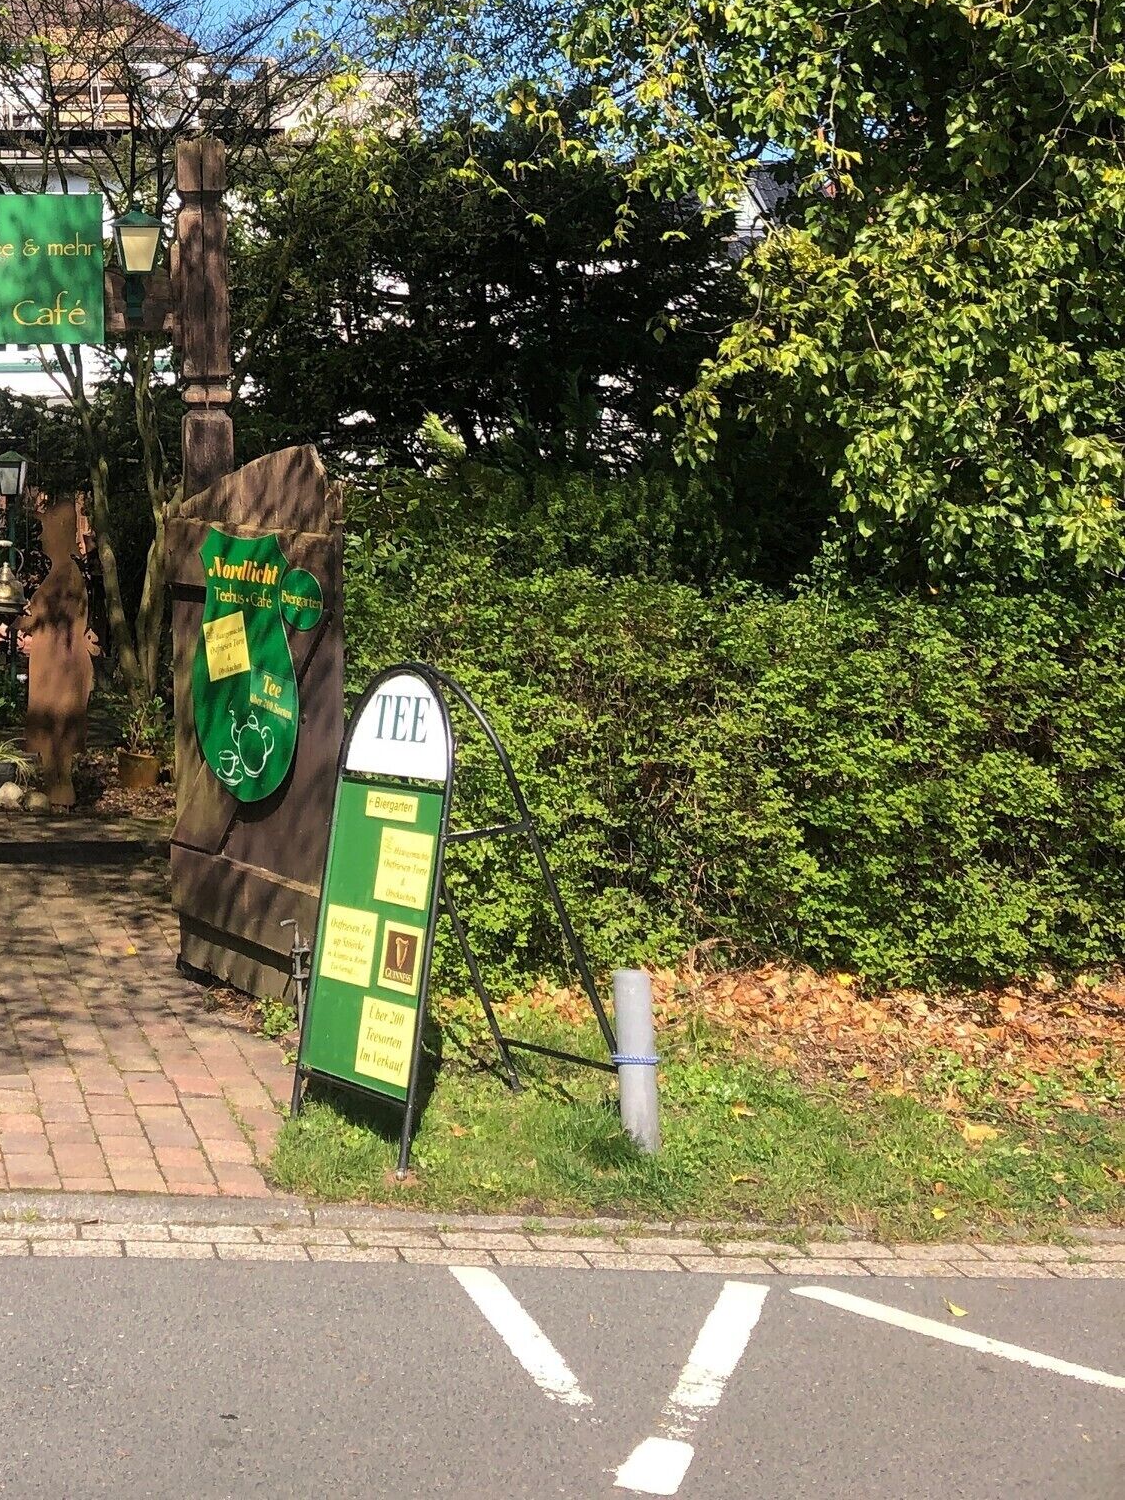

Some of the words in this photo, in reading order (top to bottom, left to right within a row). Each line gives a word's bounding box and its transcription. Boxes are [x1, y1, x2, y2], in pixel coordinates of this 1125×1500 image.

[23, 240, 39, 256] &
[48, 232, 97, 256] mehr
[13, 290, 86, 327] Café
[208, 556, 279, 585] Nordlicht
[213, 584, 245, 605] Teehus
[281, 589, 323, 611] Biergarten
[264, 674, 282, 698] Tee
[375, 694, 431, 743] TEE
[374, 796, 414, 813] Biergarten
[385, 967, 412, 984] GUINNESS
[366, 1027, 402, 1049] Teesorten
[359, 1047, 371, 1063] Im
[373, 1051, 404, 1076] Verkauf
